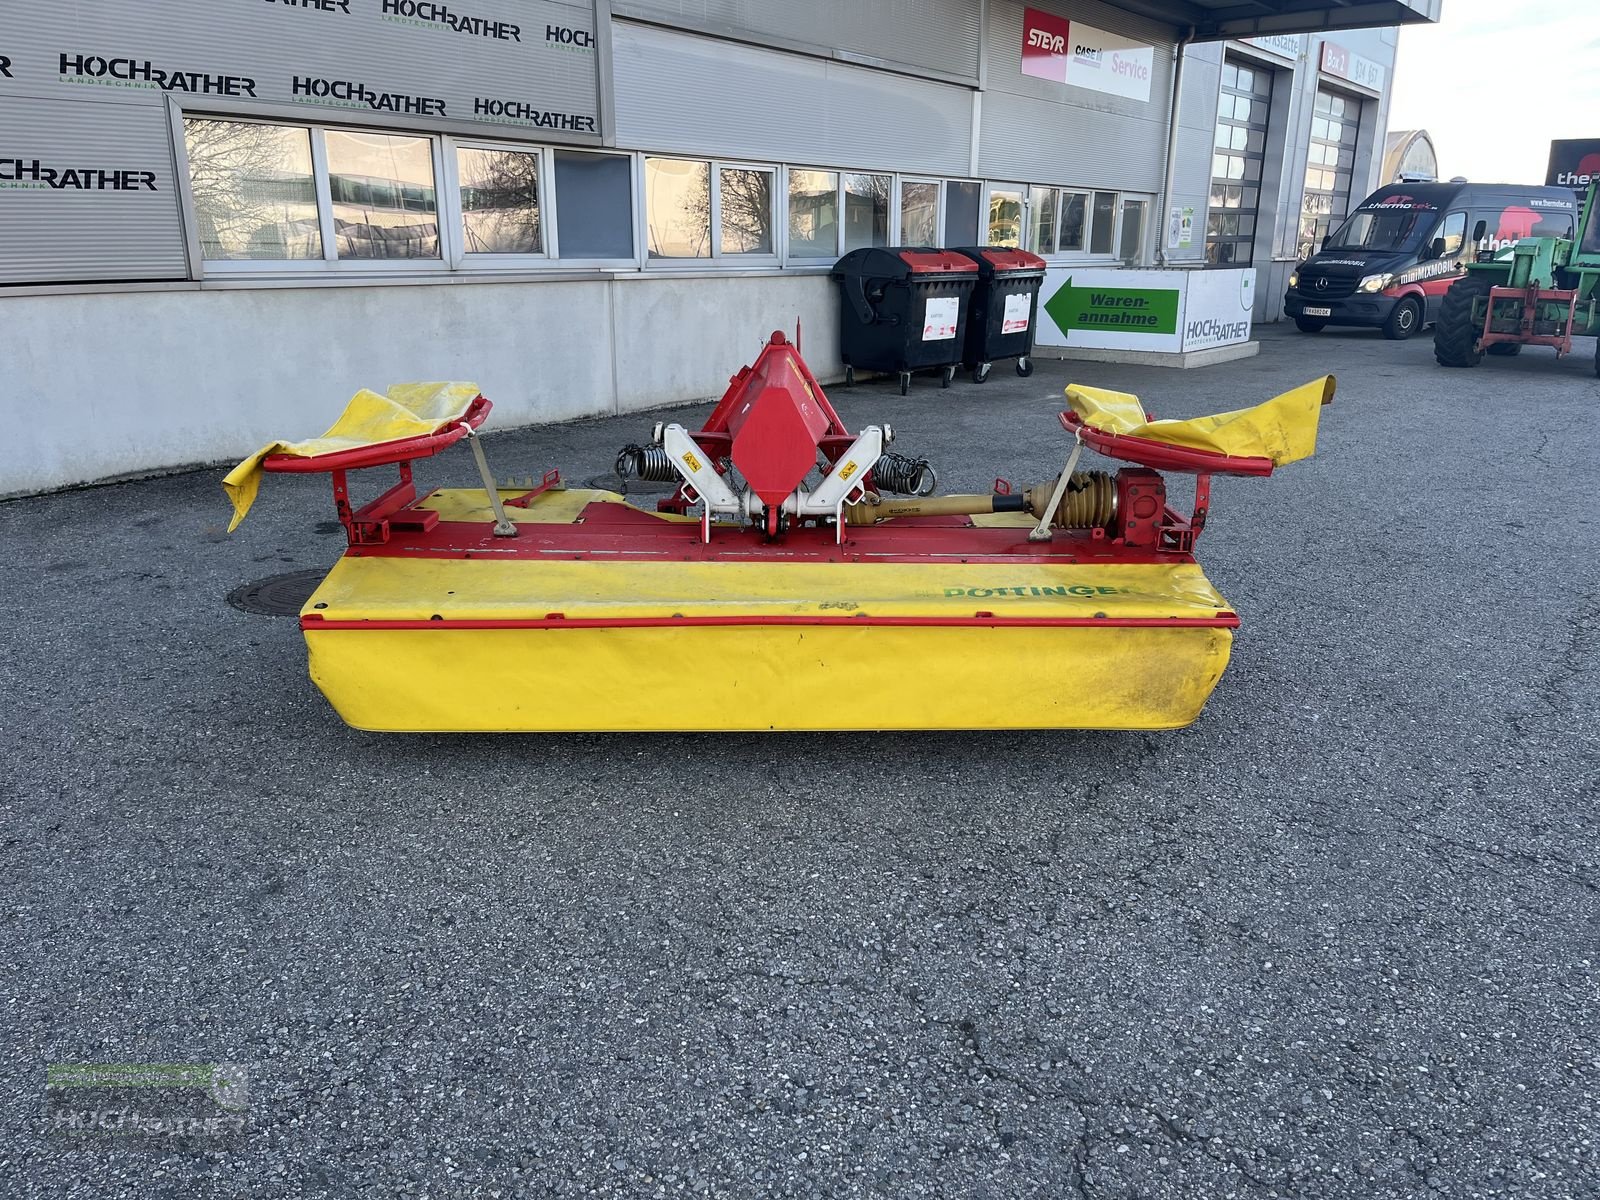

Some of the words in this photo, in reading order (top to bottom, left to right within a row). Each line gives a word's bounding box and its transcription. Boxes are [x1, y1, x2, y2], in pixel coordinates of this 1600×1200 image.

[382, 0, 521, 42] HOCHRATHER
[1027, 28, 1064, 54] STEYR
[1075, 45, 1096, 60] CASE
[1327, 49, 1340, 70] Box
[59, 53, 257, 97] HOCHRATHER
[1111, 51, 1148, 80] Service
[59, 77, 157, 90] LANDTECHNIK
[292, 75, 447, 117] HOCHRATHER
[474, 97, 595, 132] HOCHRATHER
[1557, 172, 1592, 185] the
[1090, 293, 1150, 308] Waren-
[1078, 312, 1158, 325] annahme
[1186, 319, 1248, 341] HOCHRATHER
